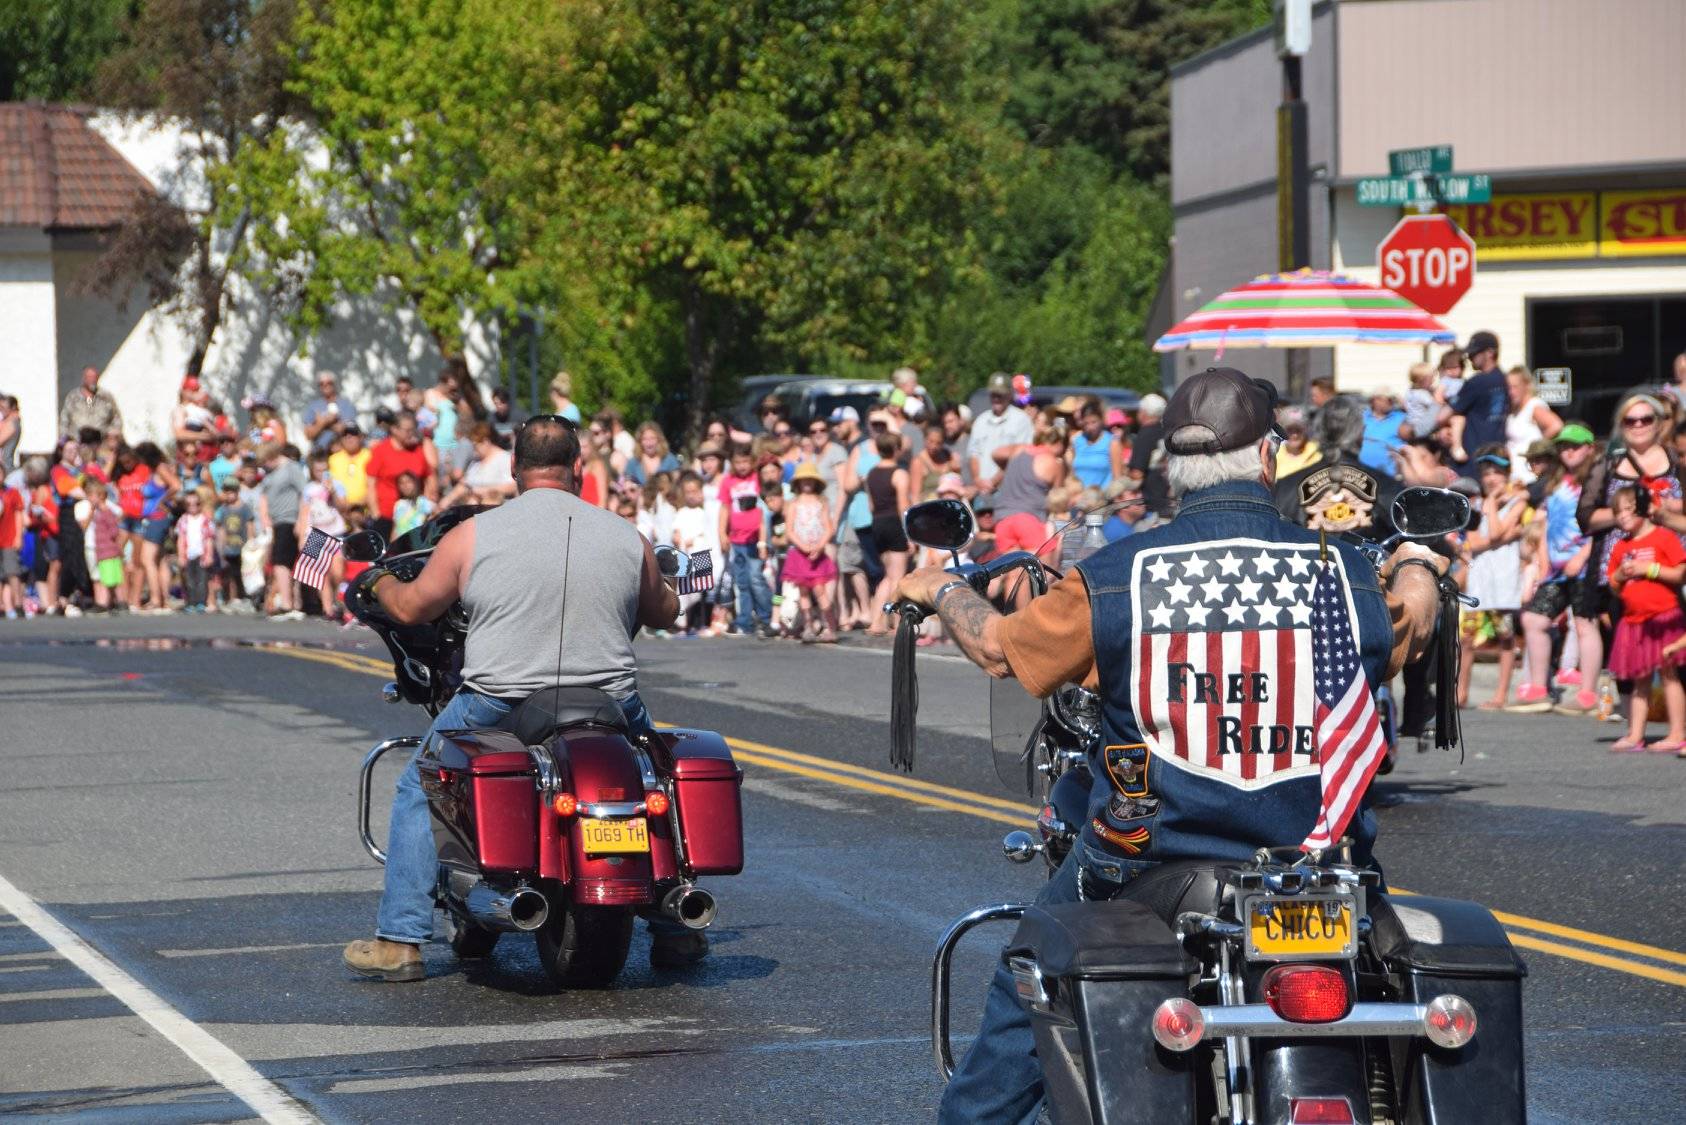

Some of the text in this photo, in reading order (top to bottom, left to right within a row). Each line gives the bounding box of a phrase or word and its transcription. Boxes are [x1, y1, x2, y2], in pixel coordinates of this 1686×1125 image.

[1358, 180, 1408, 201] SOUTH
[1384, 247, 1469, 287] STOP
[1167, 662, 1270, 704] FREE
[1217, 715, 1316, 756] RIDE
[586, 827, 645, 843] 1069 TH
